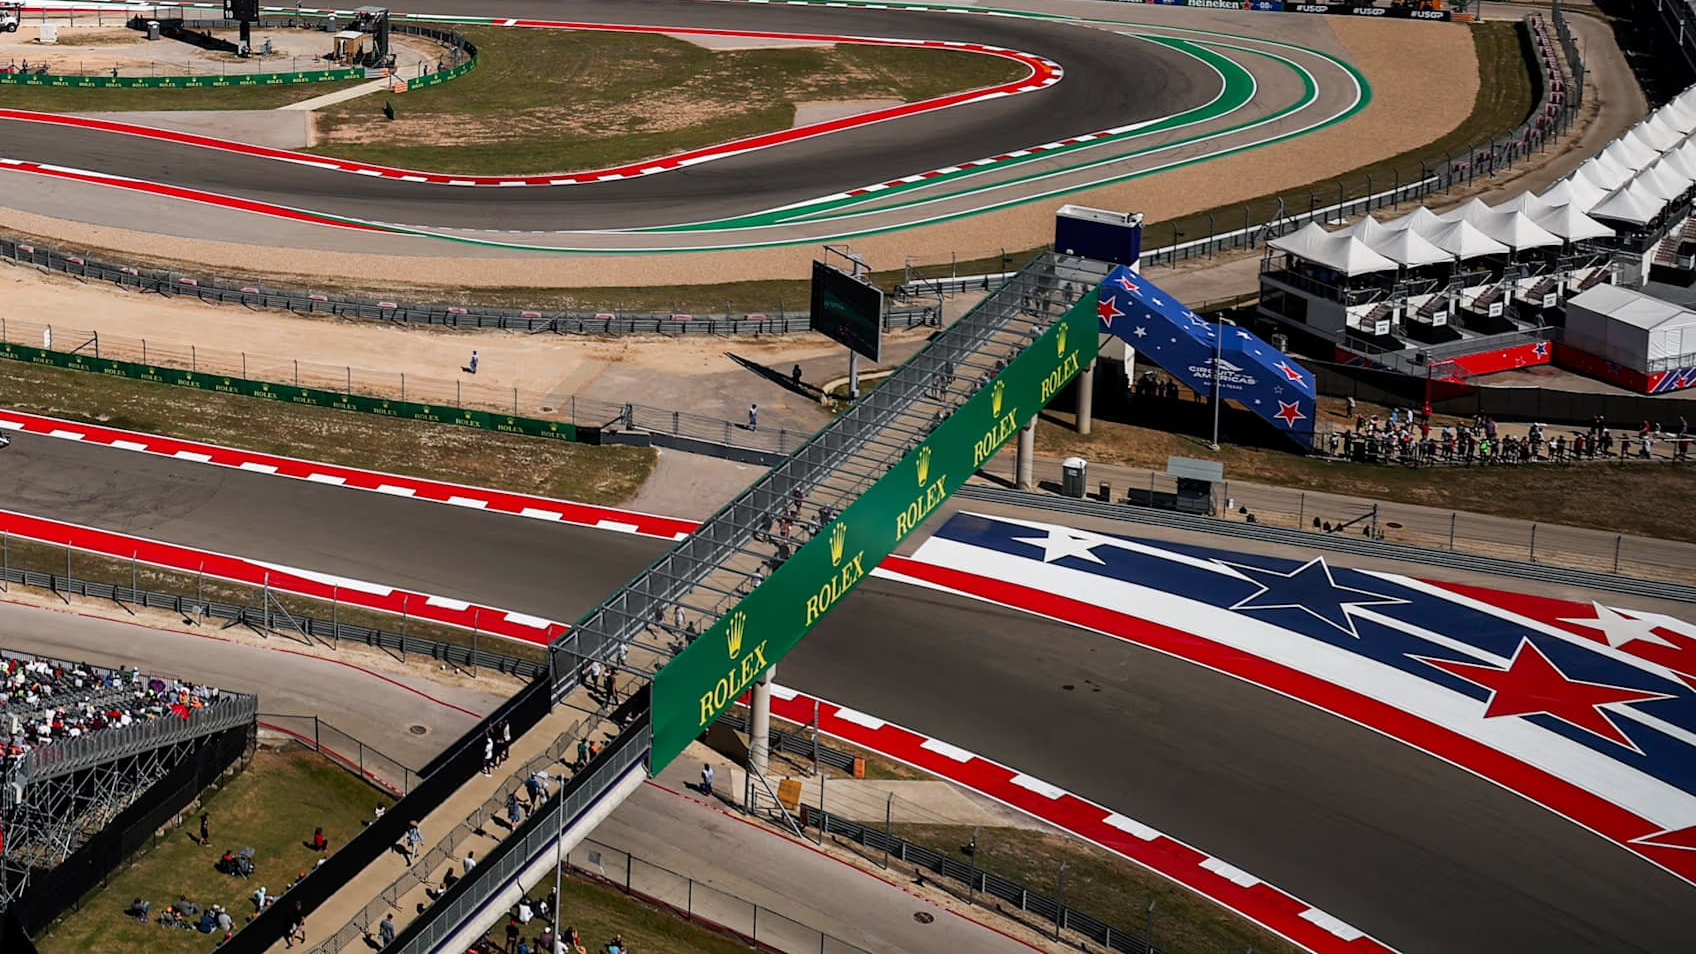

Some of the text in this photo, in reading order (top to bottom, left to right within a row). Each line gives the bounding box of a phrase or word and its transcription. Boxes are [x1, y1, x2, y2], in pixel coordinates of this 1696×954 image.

[226, 0, 232, 8] 9
[225, 10, 234, 19] 10
[33, 355, 54, 364] ROLEX
[104, 366, 125, 375] ROLEX
[141, 372, 163, 382] ROLEX
[1040, 349, 1082, 404] ROLEX
[178, 379, 200, 387] ROLEX
[215, 384, 238, 394] ROLEX
[254, 390, 277, 399] ROLEX
[293, 395, 317, 405] ROLEX
[333, 402, 356, 410] ROLEX
[373, 407, 398, 417] ROLEX
[414, 412, 439, 422] ROLEX
[455, 418, 481, 428] ROLEX
[497, 423, 524, 433] ROLEX
[540, 429, 566, 439] ROLEX
[972, 407, 1018, 468] ROLEX
[895, 473, 948, 542] ROLEX
[805, 550, 865, 628] ROLEX
[699, 639, 770, 728] ROLEX
